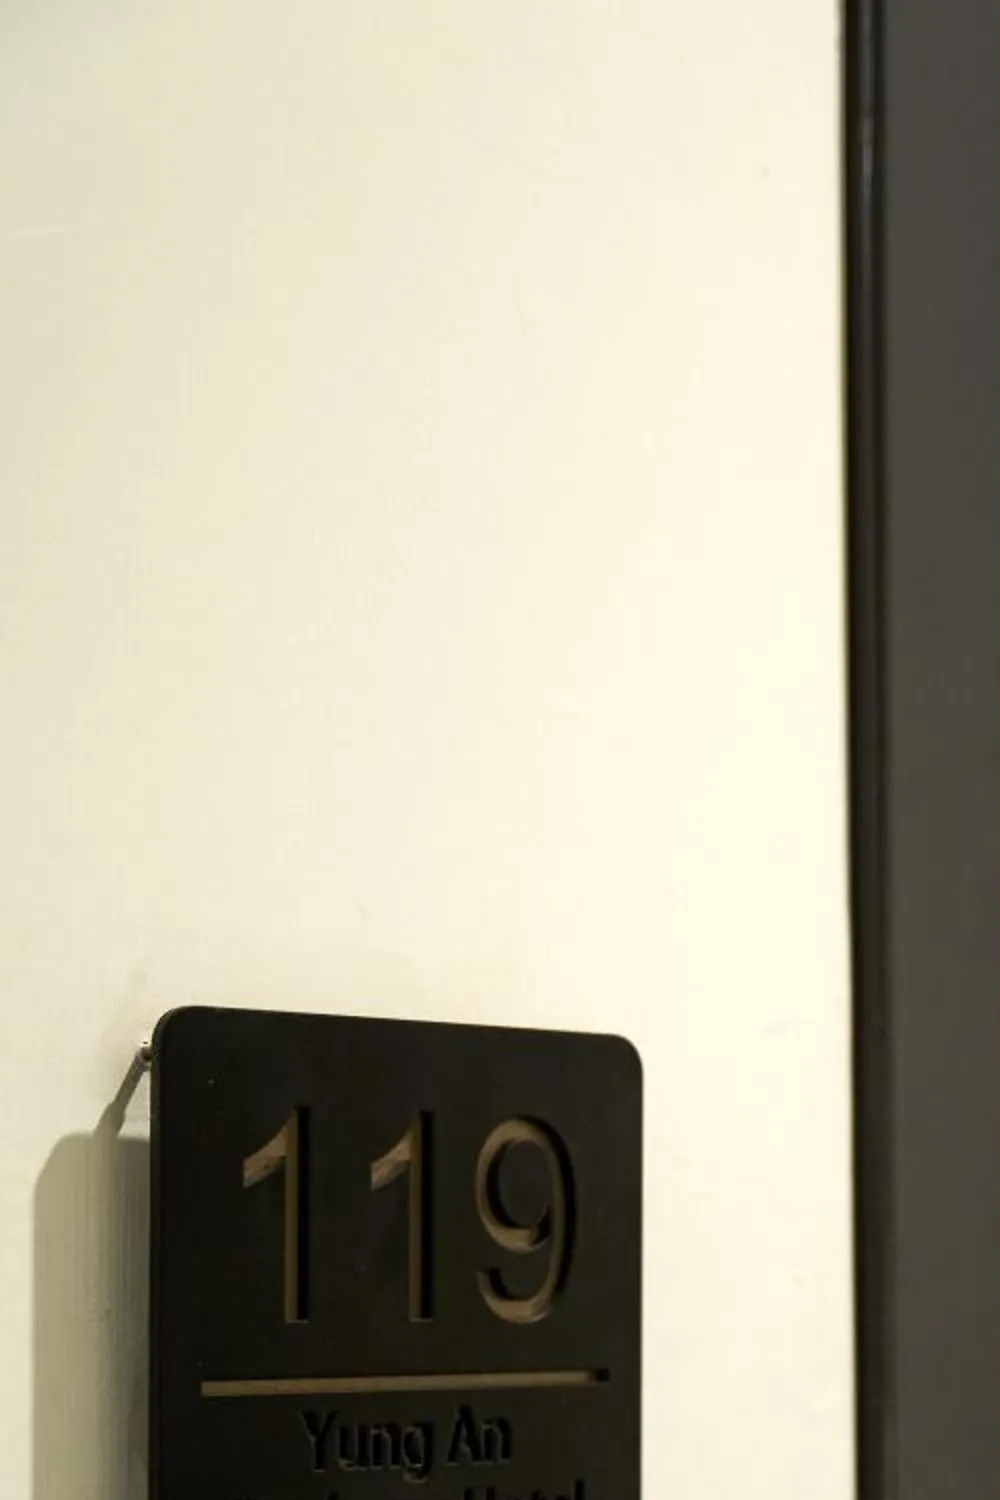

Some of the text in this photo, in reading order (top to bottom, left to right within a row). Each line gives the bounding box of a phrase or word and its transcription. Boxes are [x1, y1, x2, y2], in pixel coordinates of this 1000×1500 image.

[242, 1105, 577, 1323] 119
[301, 1405, 513, 1482] Yung An
